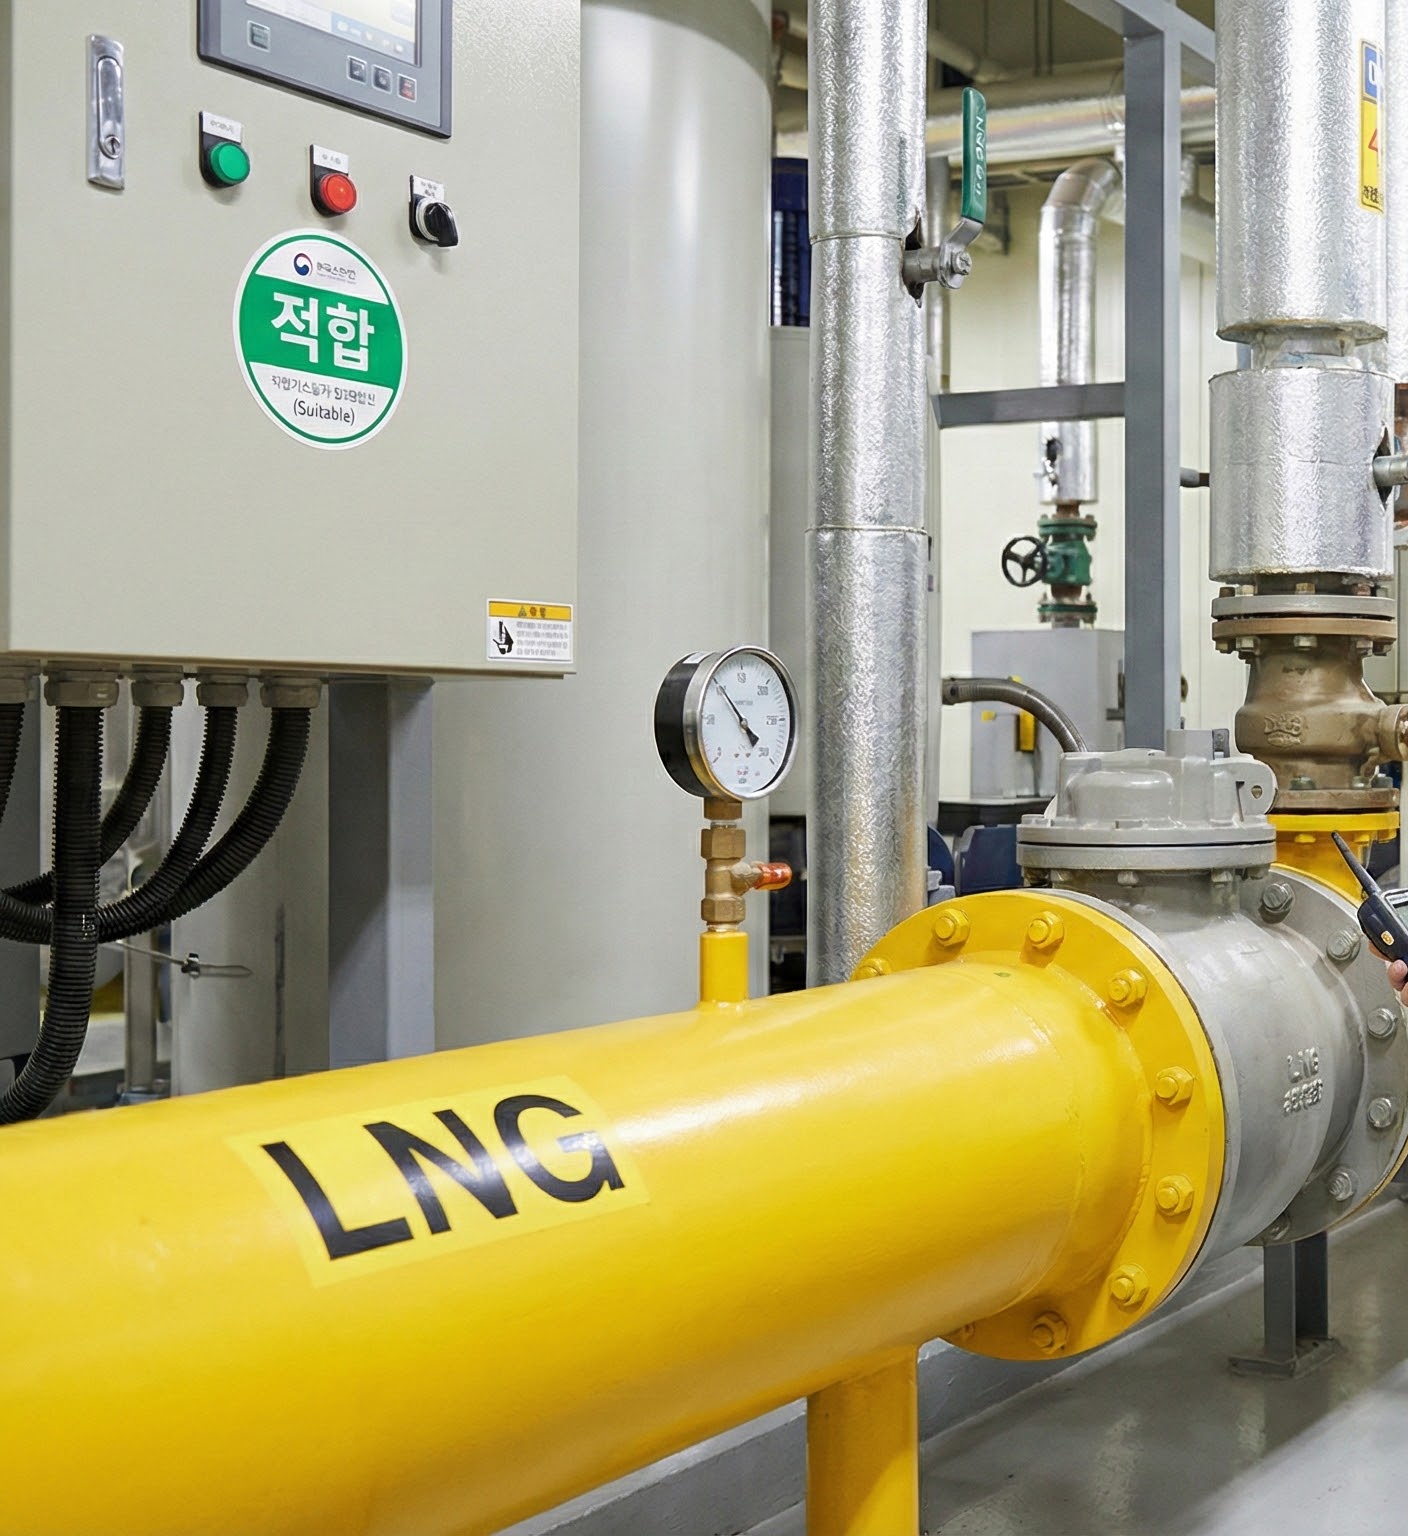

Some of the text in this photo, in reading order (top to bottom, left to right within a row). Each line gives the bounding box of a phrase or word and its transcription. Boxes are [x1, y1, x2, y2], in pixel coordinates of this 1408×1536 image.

[271, 291, 375, 372] 적합
[293, 398, 355, 426] (Suitable)
[261, 1094, 625, 1261] LNG
